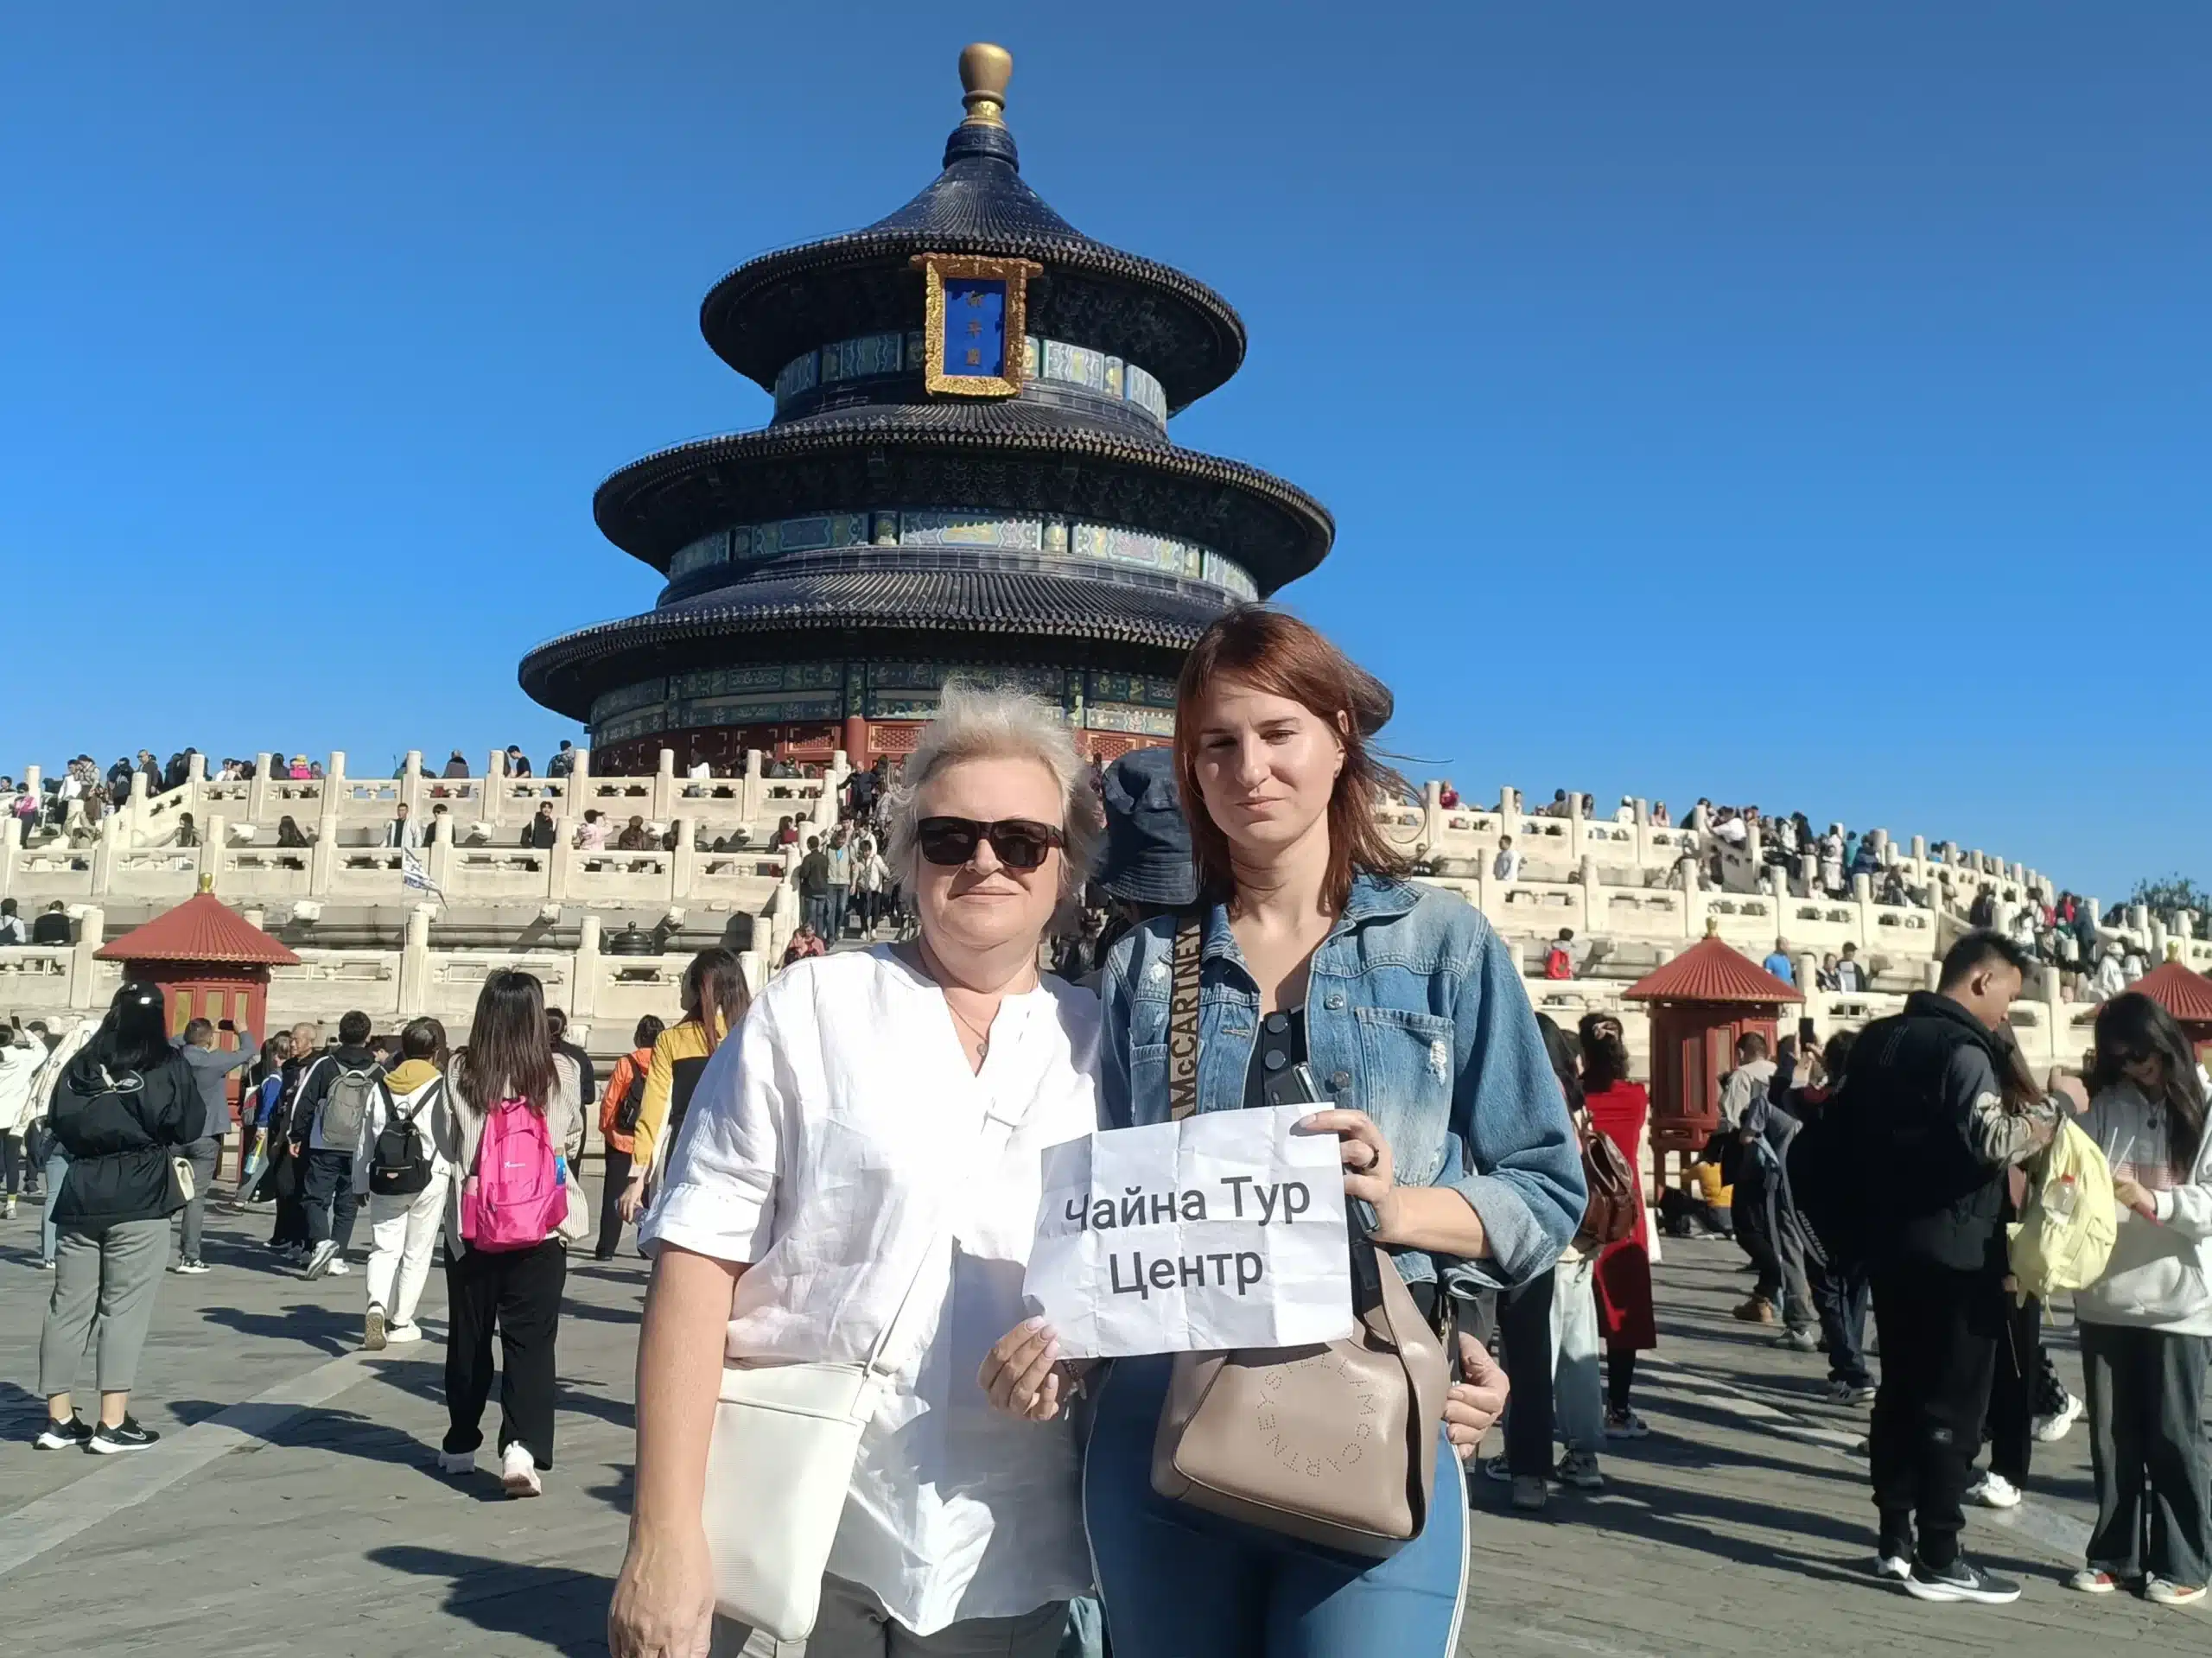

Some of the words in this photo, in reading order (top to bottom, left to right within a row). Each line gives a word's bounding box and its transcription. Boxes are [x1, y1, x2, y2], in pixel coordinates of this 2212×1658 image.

[1065, 1185, 1207, 1231] Чайна
[1220, 1176, 1311, 1225] Тур
[1109, 1251, 1263, 1300] Центр
